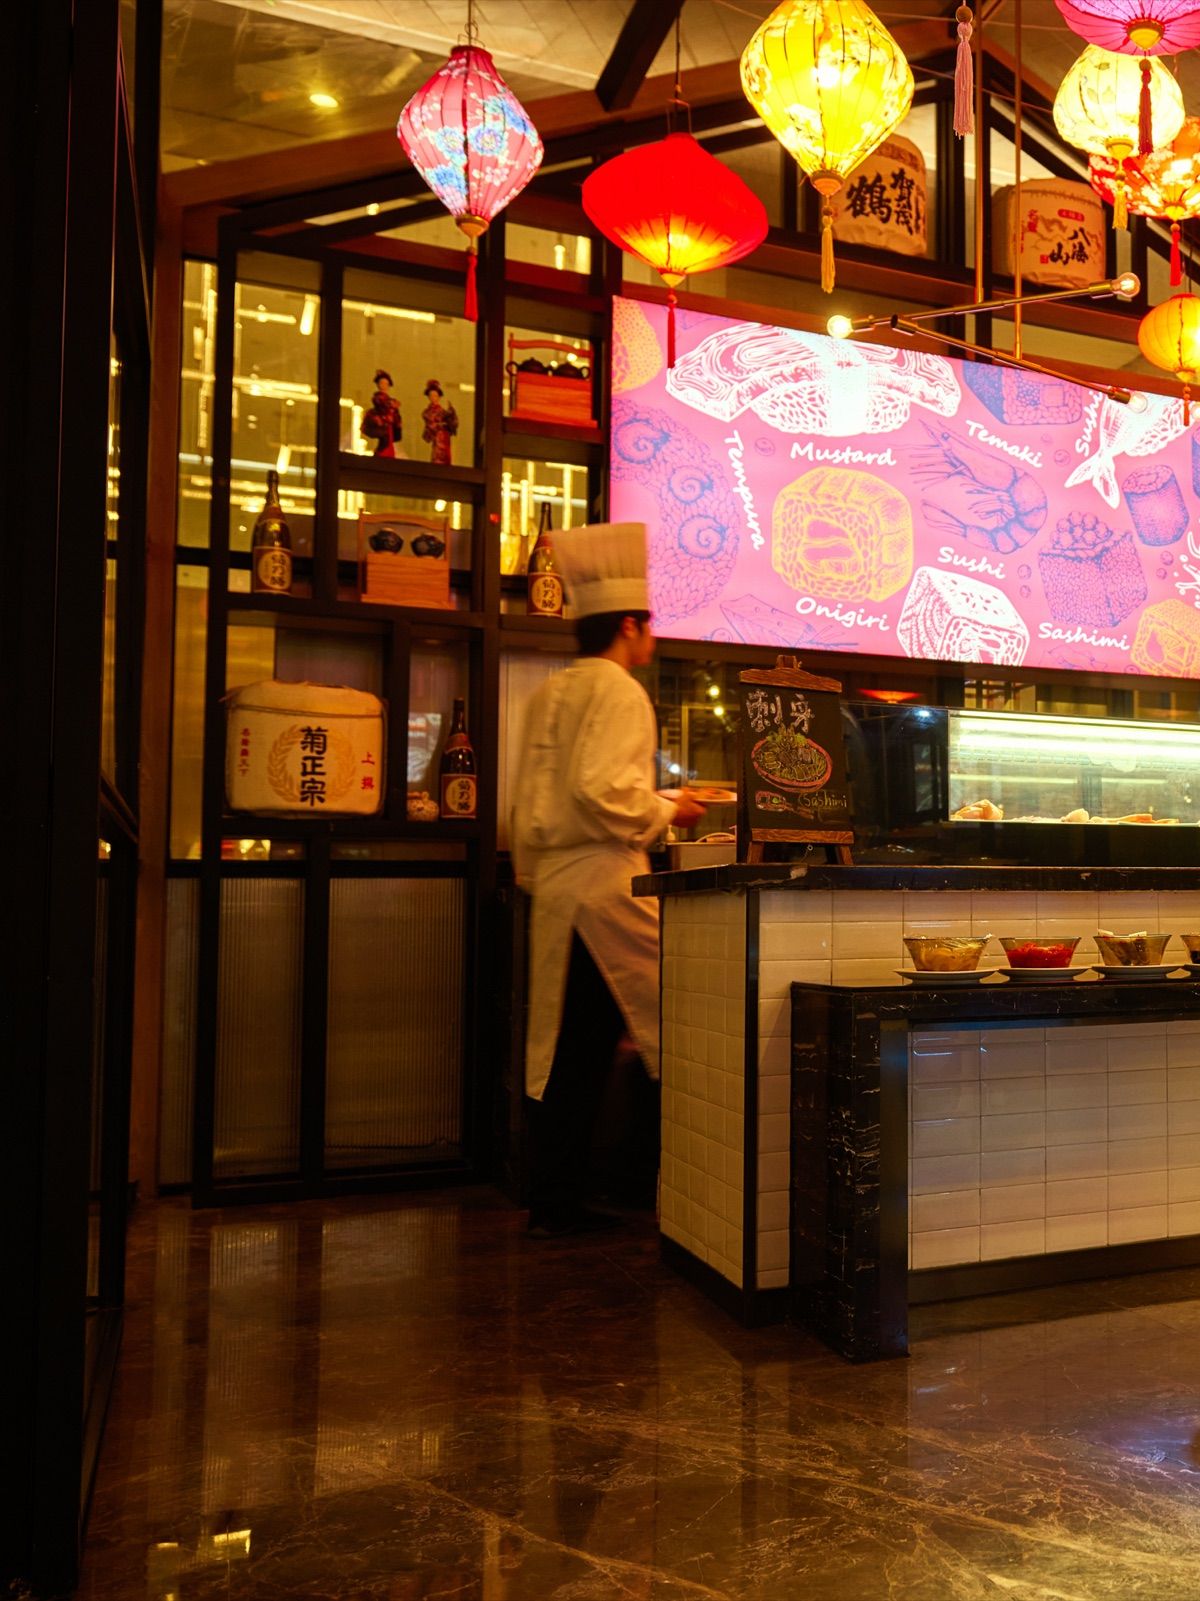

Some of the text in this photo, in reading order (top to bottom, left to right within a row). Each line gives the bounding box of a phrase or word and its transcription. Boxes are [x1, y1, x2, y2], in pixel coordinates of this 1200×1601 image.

[965, 419, 1043, 468] Temaki
[1075, 390, 1103, 457] Sushi
[790, 442, 896, 466] Mustard
[724, 430, 765, 550] Tempura
[937, 546, 1005, 579] Sushi
[795, 597, 890, 631] Onigiri
[1038, 622, 1130, 650] Sashimi
[299, 726, 328, 806] 菊正宗
